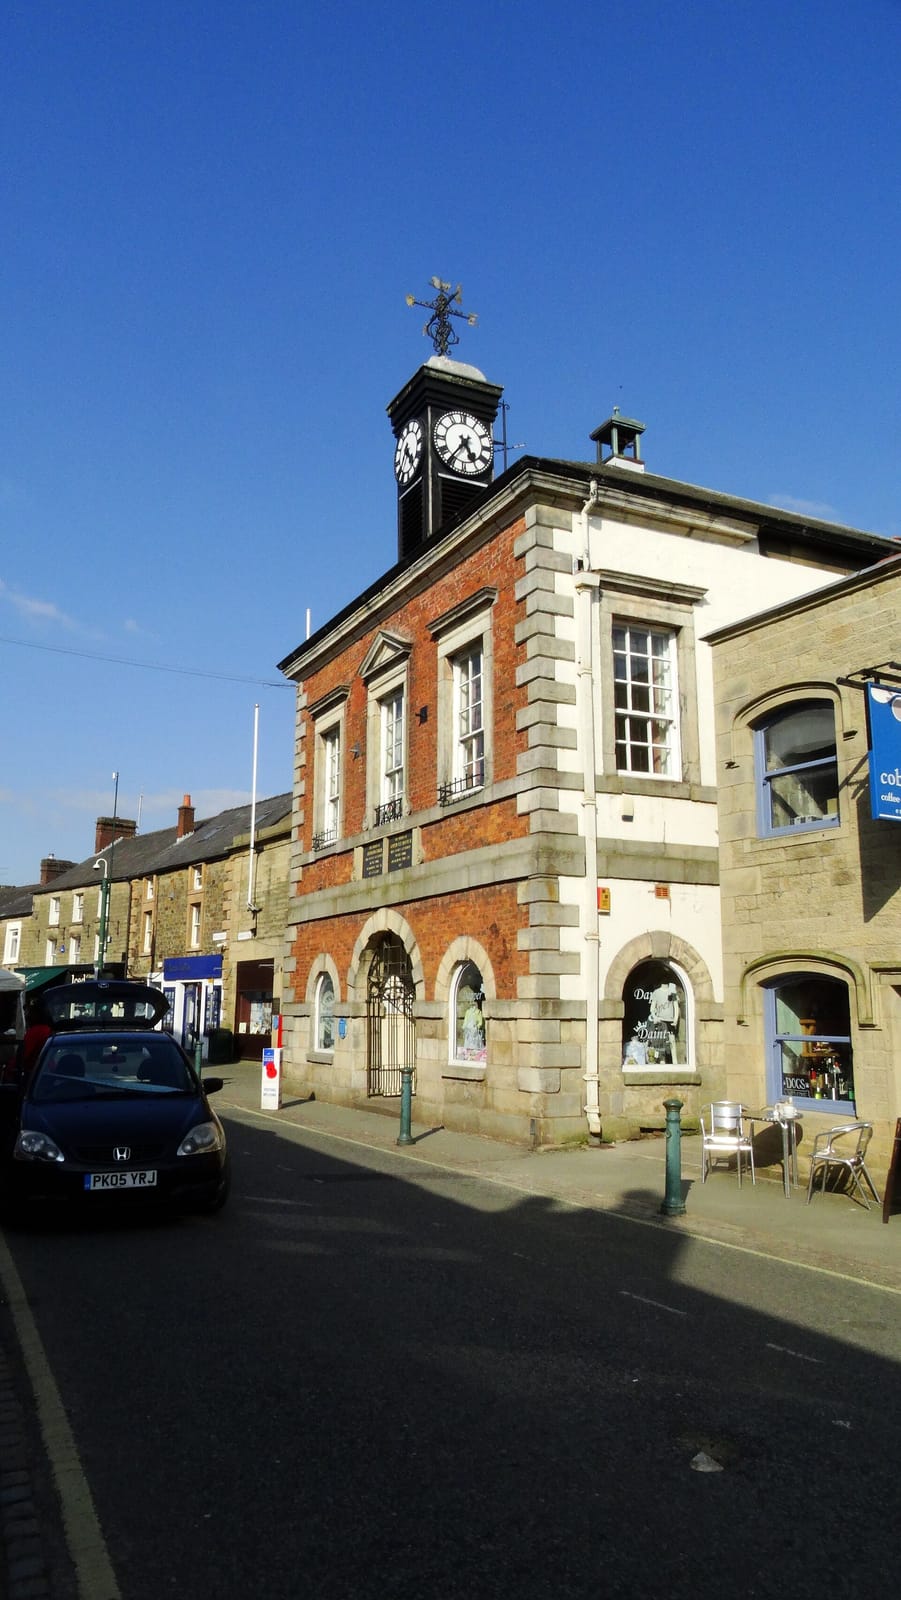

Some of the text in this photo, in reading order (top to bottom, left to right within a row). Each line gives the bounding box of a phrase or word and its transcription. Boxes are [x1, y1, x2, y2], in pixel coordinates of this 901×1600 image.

[638, 1028, 673, 1043] Dainty
[93, 1171, 155, 1187] PK05 YRJ
